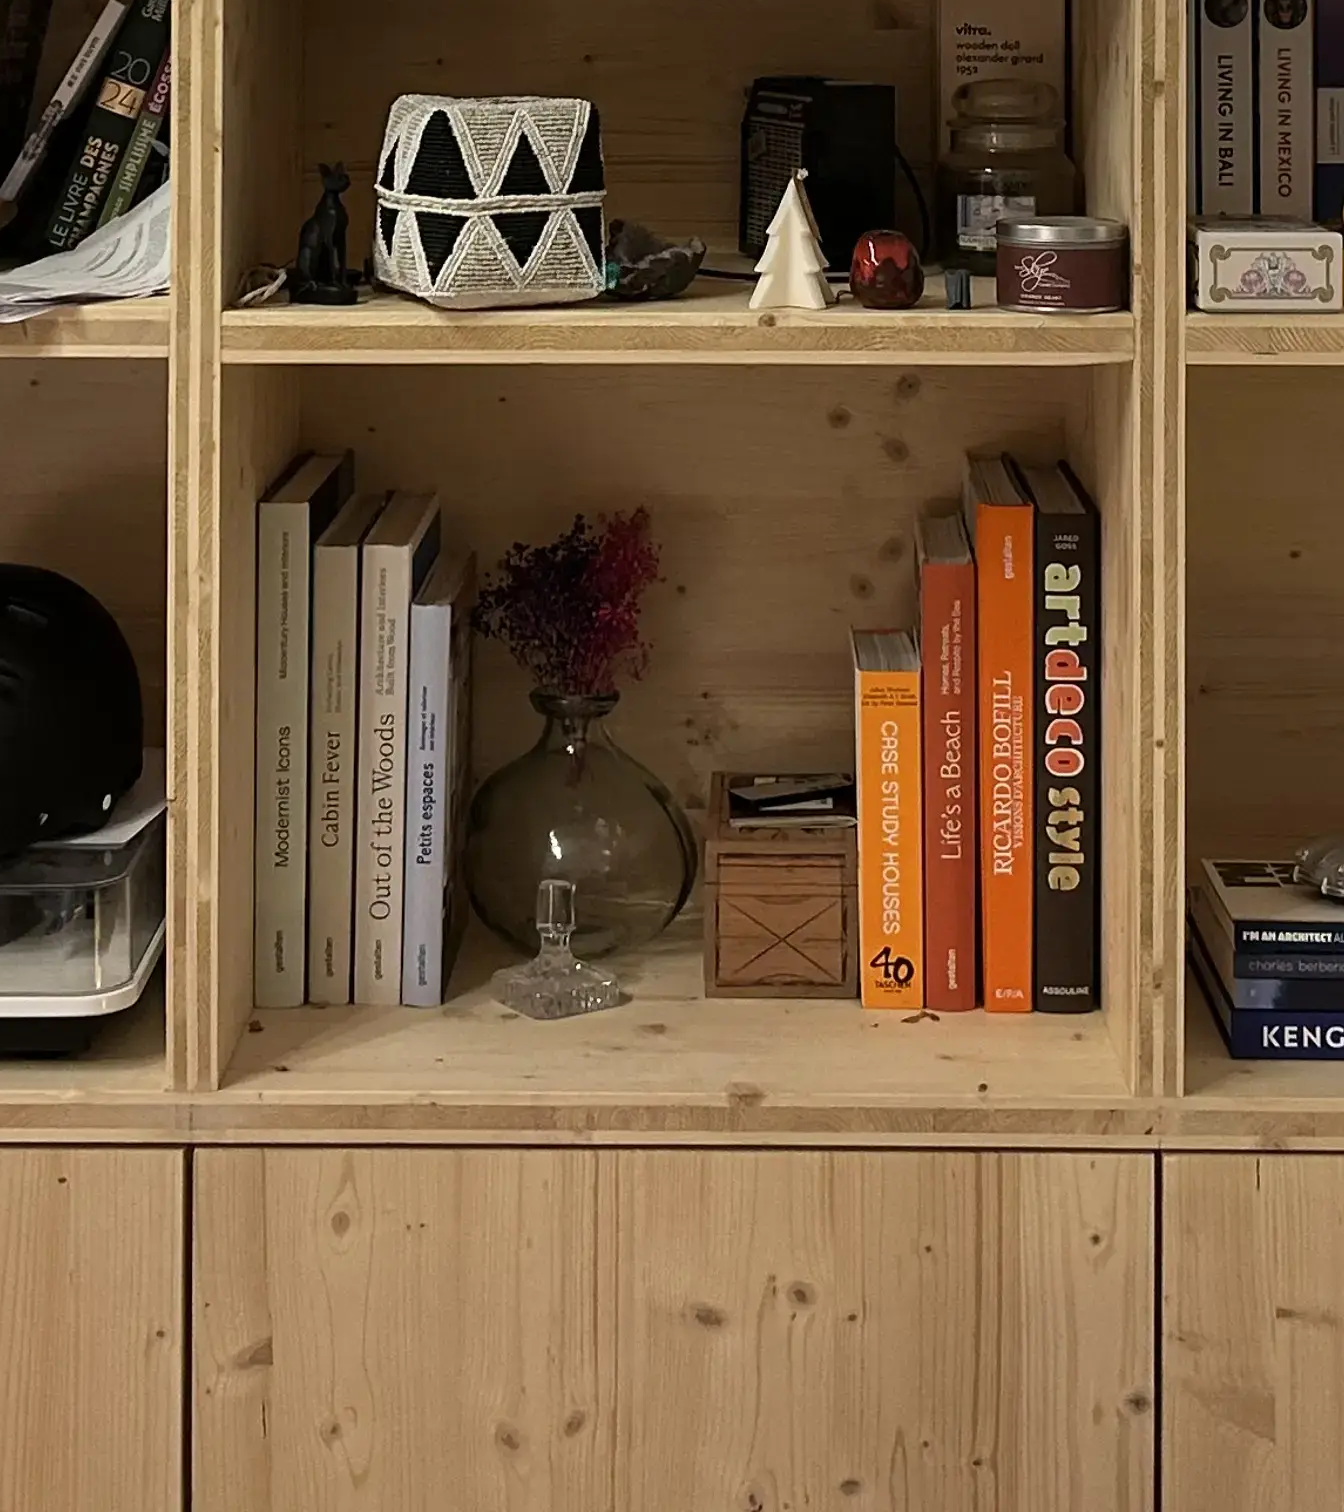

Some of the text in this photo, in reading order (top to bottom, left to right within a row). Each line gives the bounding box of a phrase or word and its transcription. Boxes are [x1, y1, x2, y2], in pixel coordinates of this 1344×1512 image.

[111, 50, 151, 86] 20
[955, 39, 998, 51] wooden
[955, 52, 1008, 64] alexander
[101, 81, 137, 116] 24
[1217, 54, 1234, 187] LIVING IN BALI
[1276, 47, 1292, 198] LIVING IN MEXICO
[50, 136, 103, 248] LE LIVRE DES
[993, 670, 1012, 760] BOFILL
[274, 726, 292, 773] Icons
[321, 731, 341, 784] Fever
[372, 714, 395, 793] Woods
[940, 710, 961, 779] Beach
[371, 798, 394, 836] the
[421, 763, 436, 820] espaces
[945, 784, 962, 799] a
[274, 778, 292, 868] Modernist
[320, 790, 340, 848] Cabin
[415, 824, 433, 865] Petits
[880, 720, 901, 935] CASE STUDY HOUSES
[940, 804, 962, 860] Life's
[992, 763, 1014, 876] RICARDO
[1046, 787, 1083, 892] style
[370, 841, 392, 867] of
[369, 873, 392, 921] Out
[1261, 930, 1276, 942] AN
[1277, 931, 1333, 944] ARCHITECT
[869, 946, 915, 985] 40
